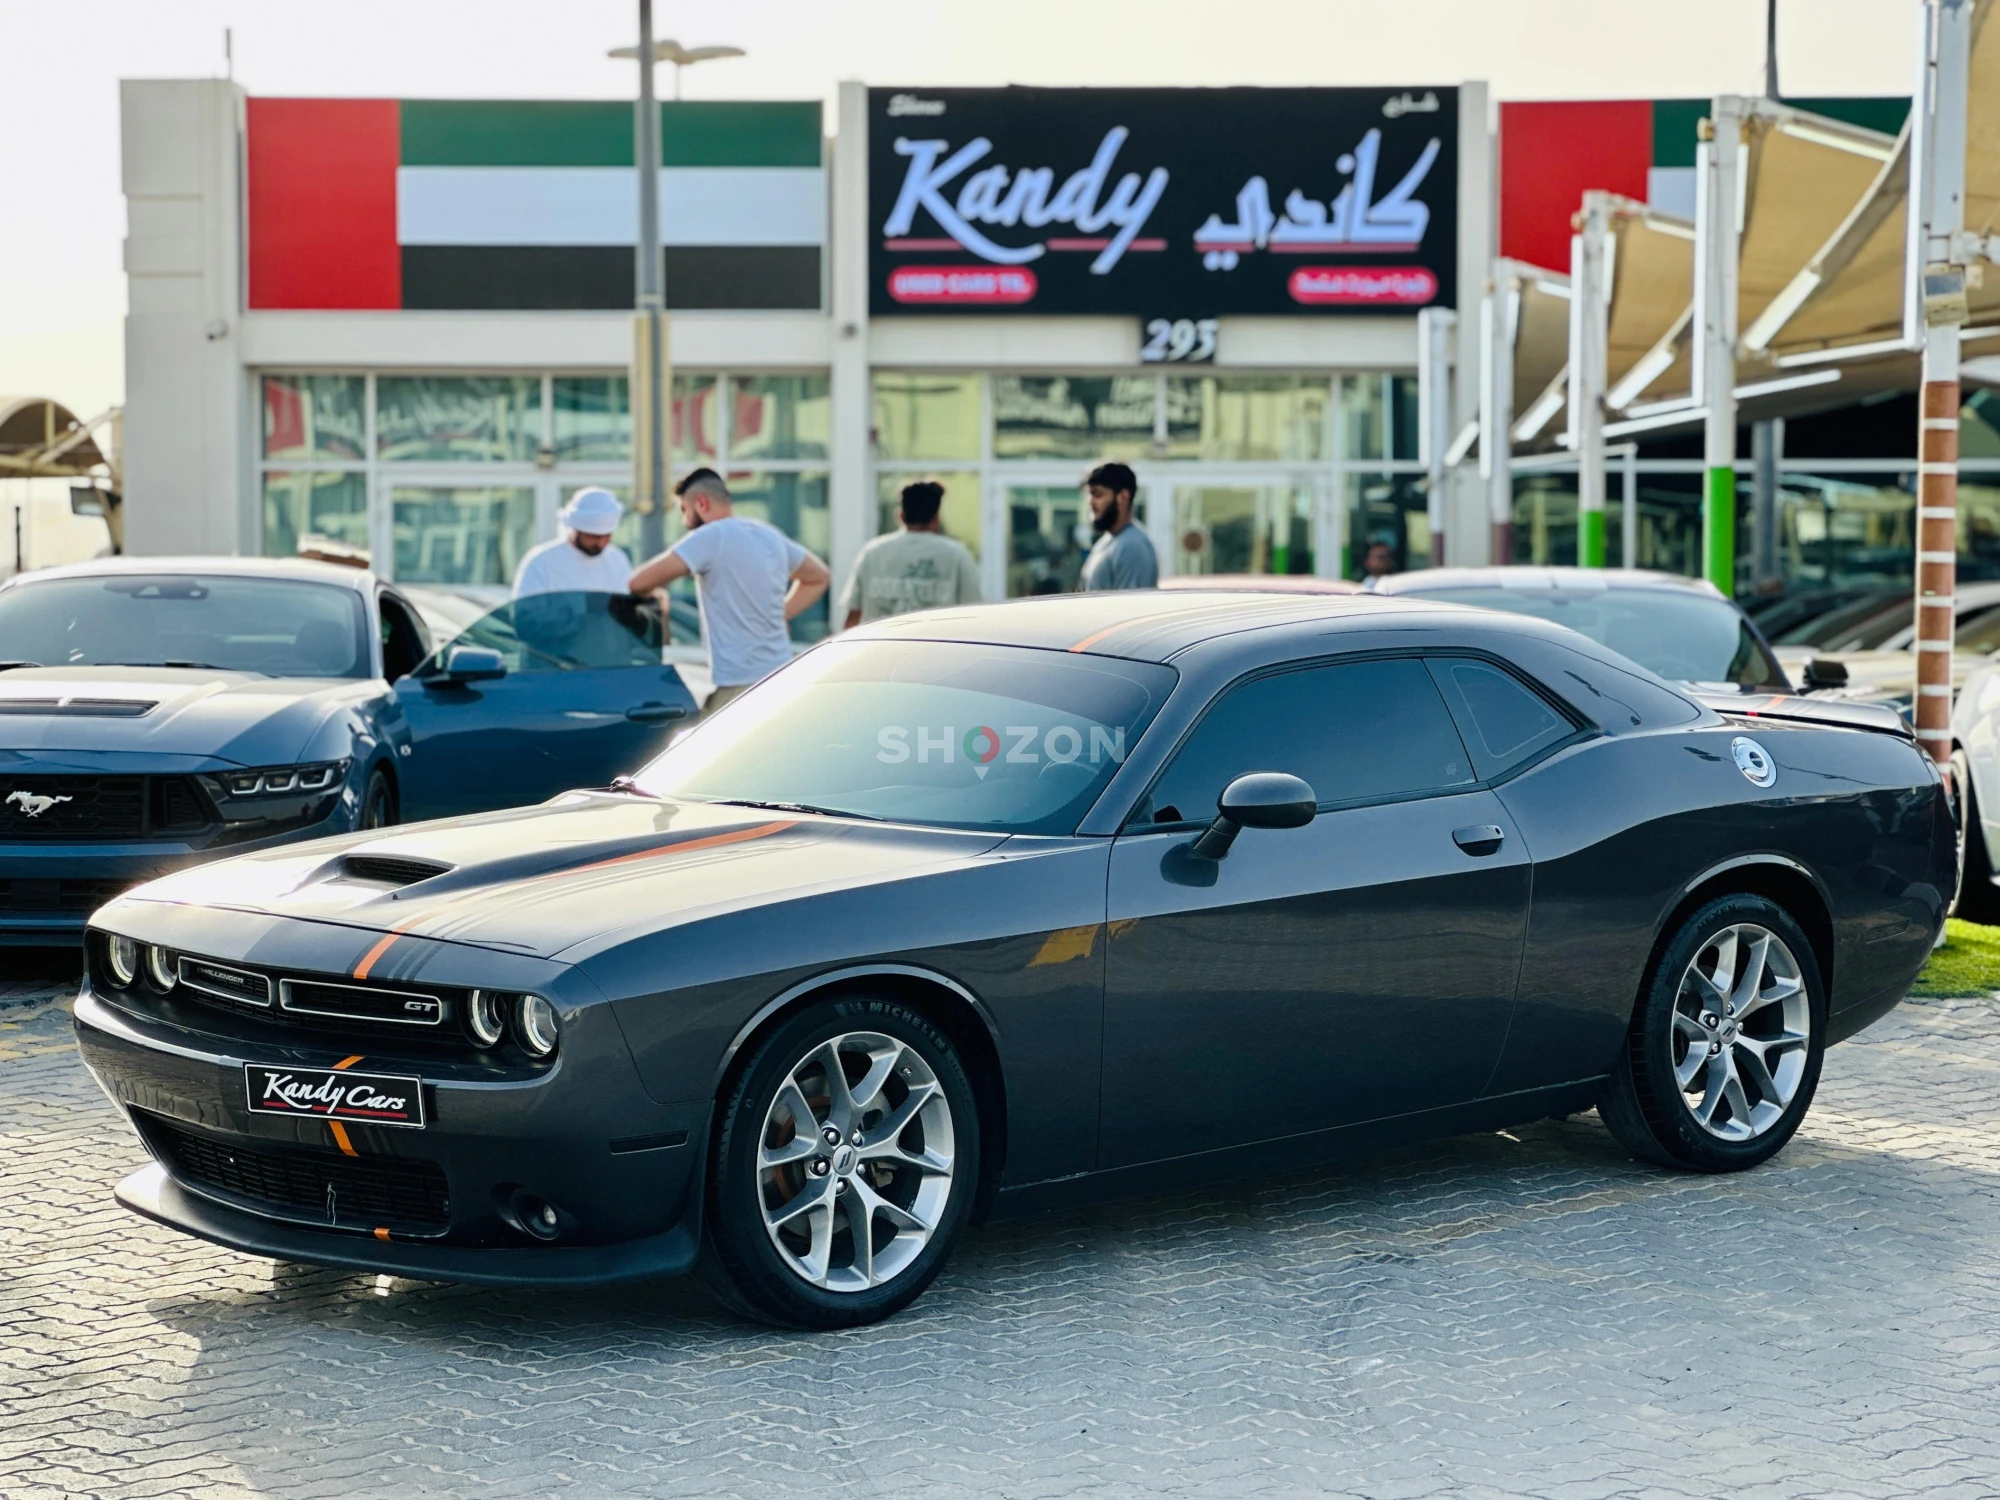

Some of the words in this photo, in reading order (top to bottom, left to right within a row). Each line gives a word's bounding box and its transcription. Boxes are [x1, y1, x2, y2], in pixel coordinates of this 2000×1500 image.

[883, 125, 1169, 274] Kandy
[1193, 128, 1441, 271] كاندي
[1141, 318, 1219, 361] 295
[404, 1001, 438, 1012] GT
[869, 1002, 946, 1050] MICHELIN
[263, 1072, 346, 1114] Kandy
[346, 1086, 406, 1110] Cars
